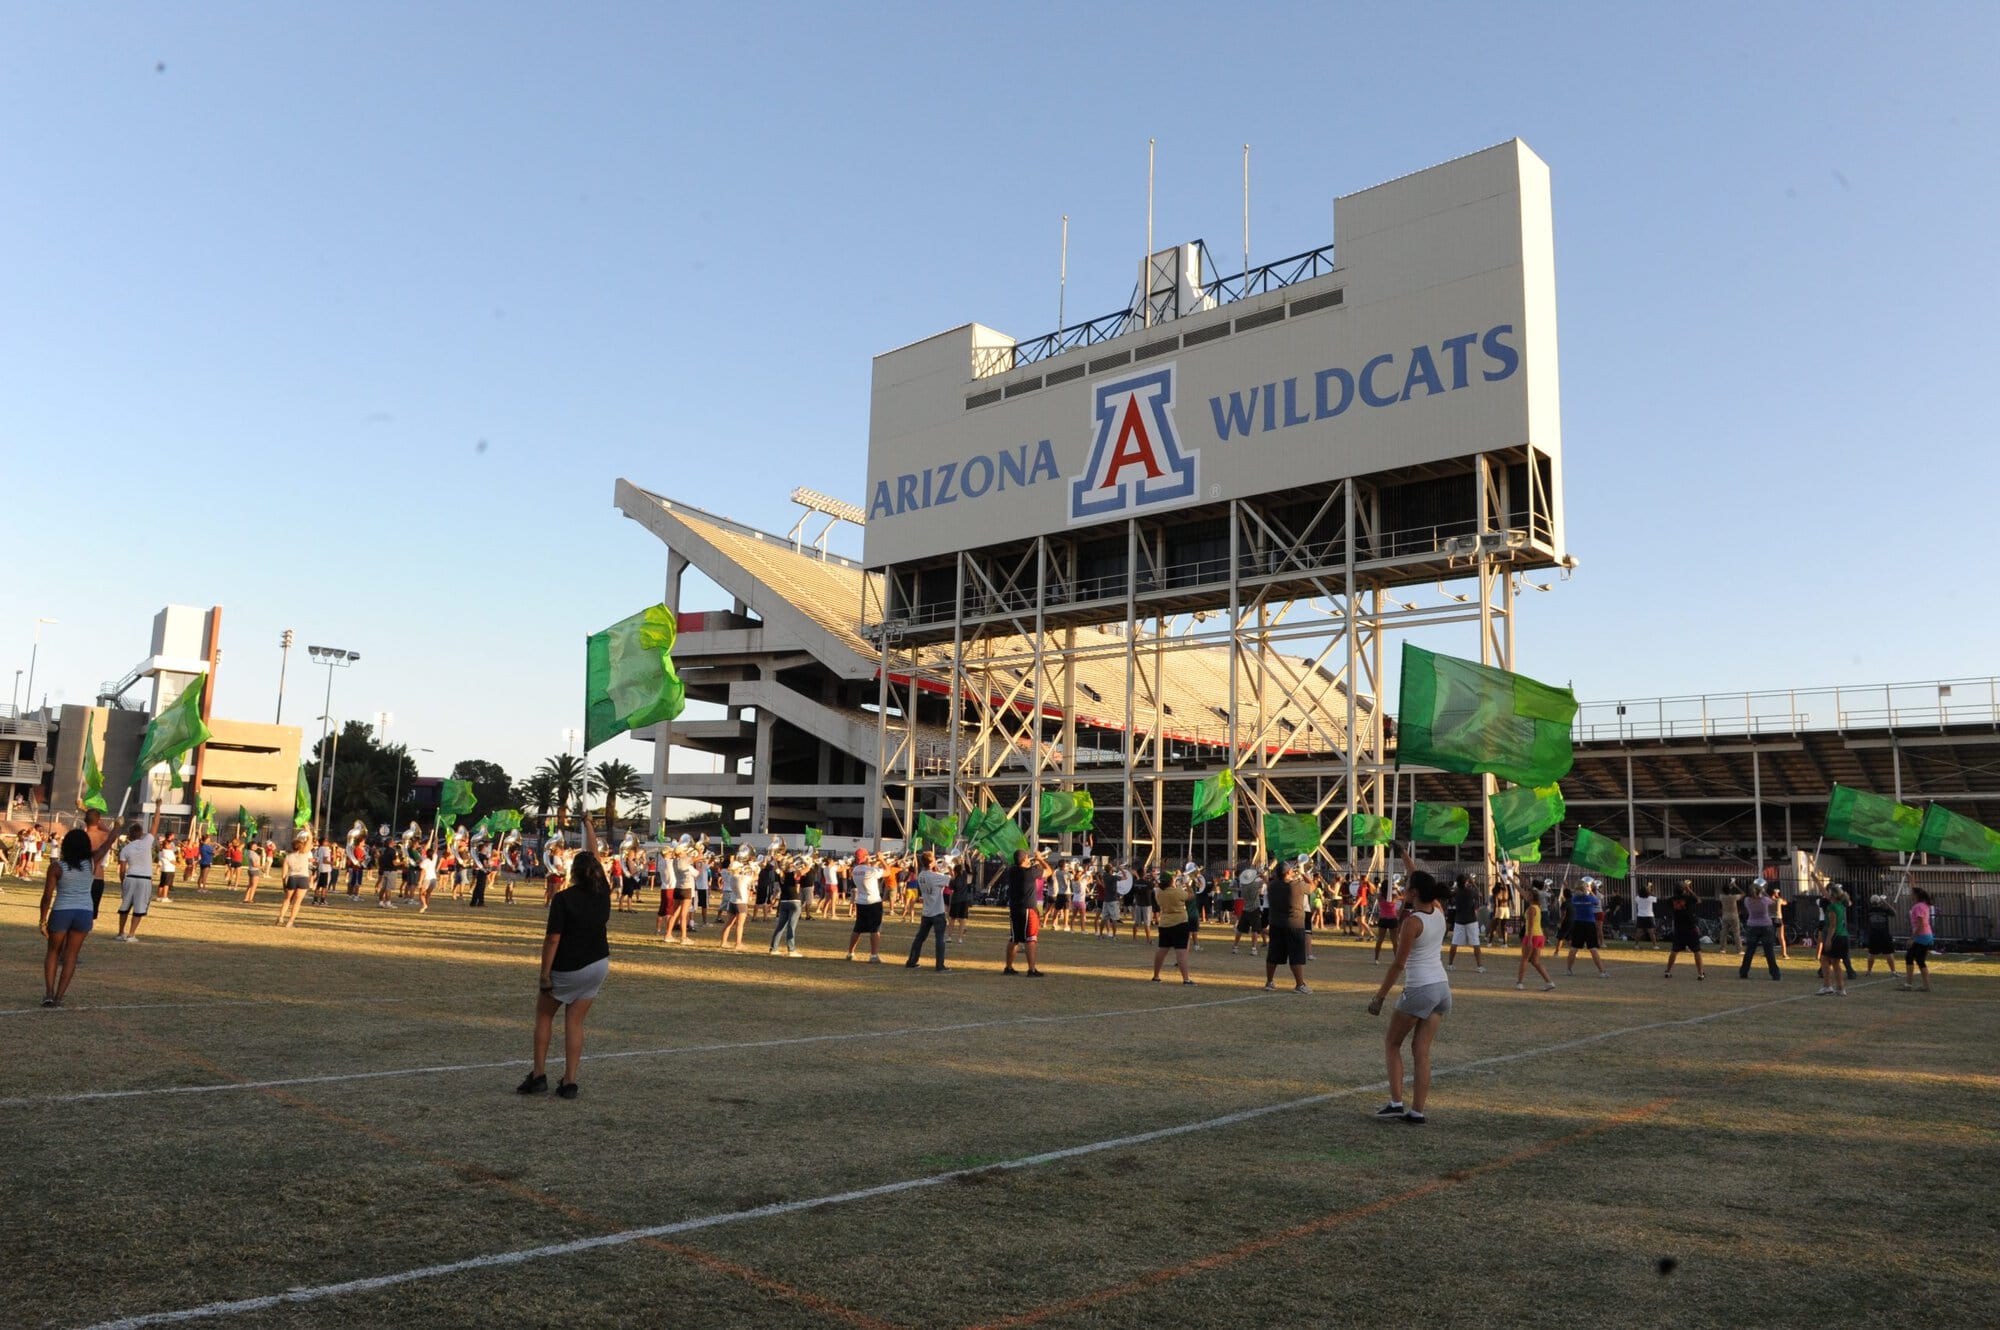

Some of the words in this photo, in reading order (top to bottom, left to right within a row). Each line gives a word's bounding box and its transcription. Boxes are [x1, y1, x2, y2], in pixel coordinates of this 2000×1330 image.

[868, 439, 1061, 520] ARIZONA
[1071, 366, 1196, 519] A
[1208, 324, 1519, 441] WILDCATS
